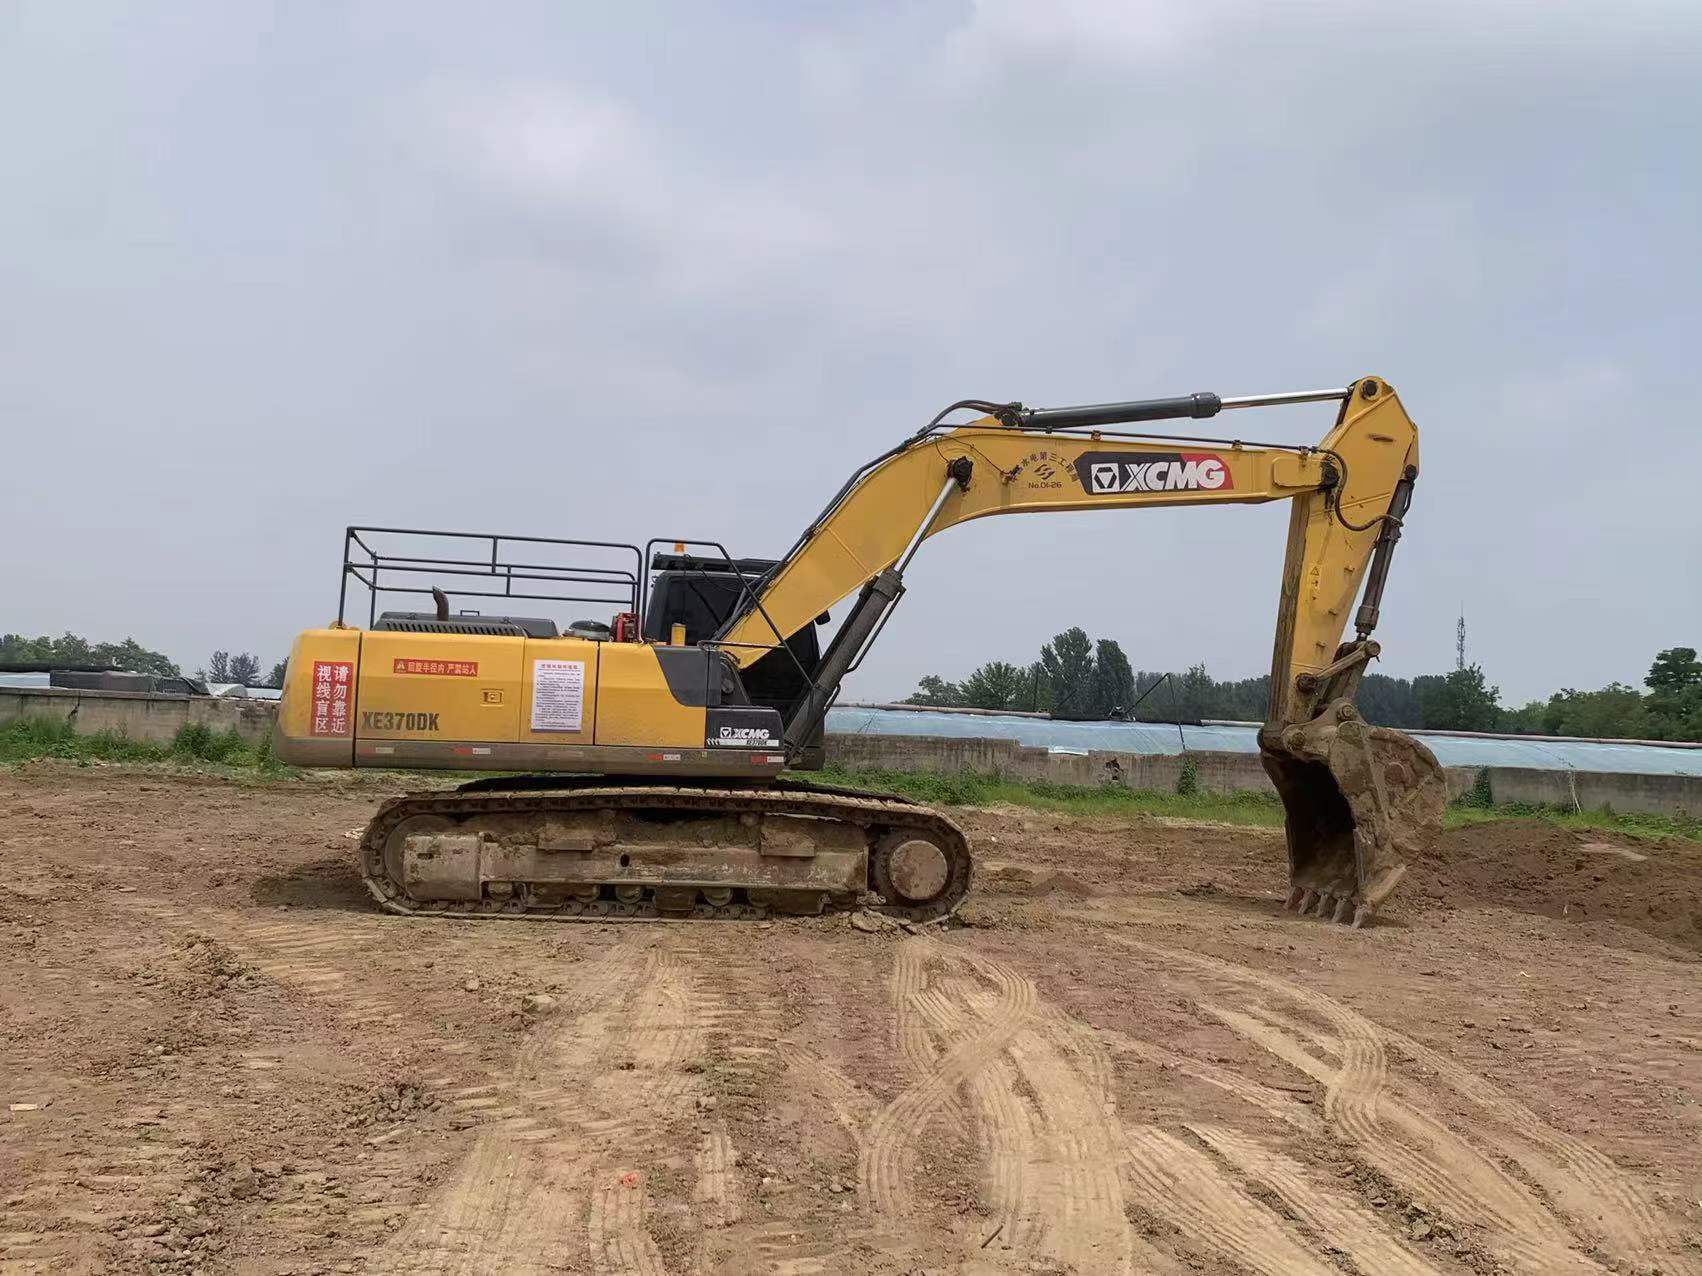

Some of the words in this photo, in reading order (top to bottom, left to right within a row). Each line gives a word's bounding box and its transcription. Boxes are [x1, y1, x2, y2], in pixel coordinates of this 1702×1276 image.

[1121, 459, 1225, 491] XCMG
[315, 664, 331, 733] 视线盲区
[331, 665, 349, 733] 请勿靠近
[361, 711, 440, 731] XE370DK
[732, 728, 770, 739] XCMG
